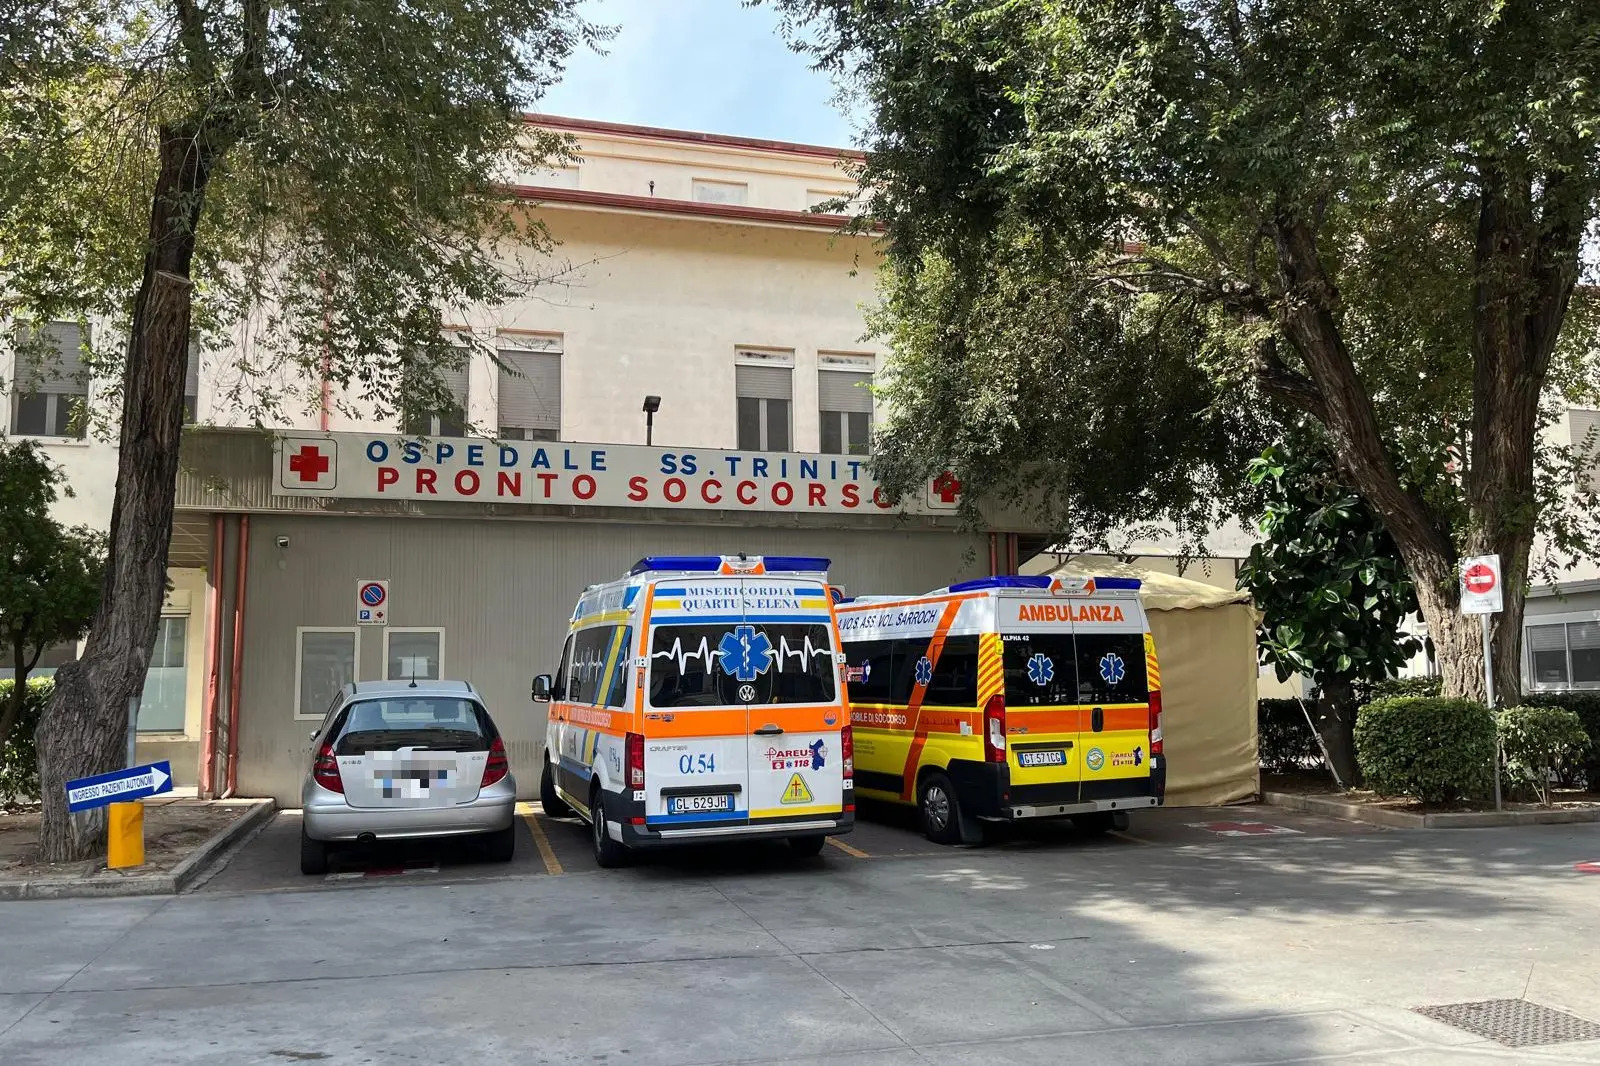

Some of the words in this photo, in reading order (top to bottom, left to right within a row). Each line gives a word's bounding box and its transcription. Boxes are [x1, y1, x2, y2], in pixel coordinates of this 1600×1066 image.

[366, 440, 606, 471] OSPEDALE
[377, 467, 597, 500] PRONTO
[688, 586, 793, 597] MISERICORDIA
[682, 599, 738, 612] QUARTU
[1018, 604, 1124, 622] AMBULANZA
[896, 609, 938, 626] SARROCH
[875, 713, 907, 725] SOCCORSO
[698, 752, 715, 774] 54
[794, 759, 809, 768] 118
[1024, 754, 1034, 764] GT
[1036, 752, 1060, 763] 571CG
[72, 786, 100, 801] INGRESSO
[101, 781, 126, 795] PAZIENTI
[126, 775, 154, 789] AUTONOMI
[676, 798, 690, 810] GL
[693, 795, 727, 809] 629JH
